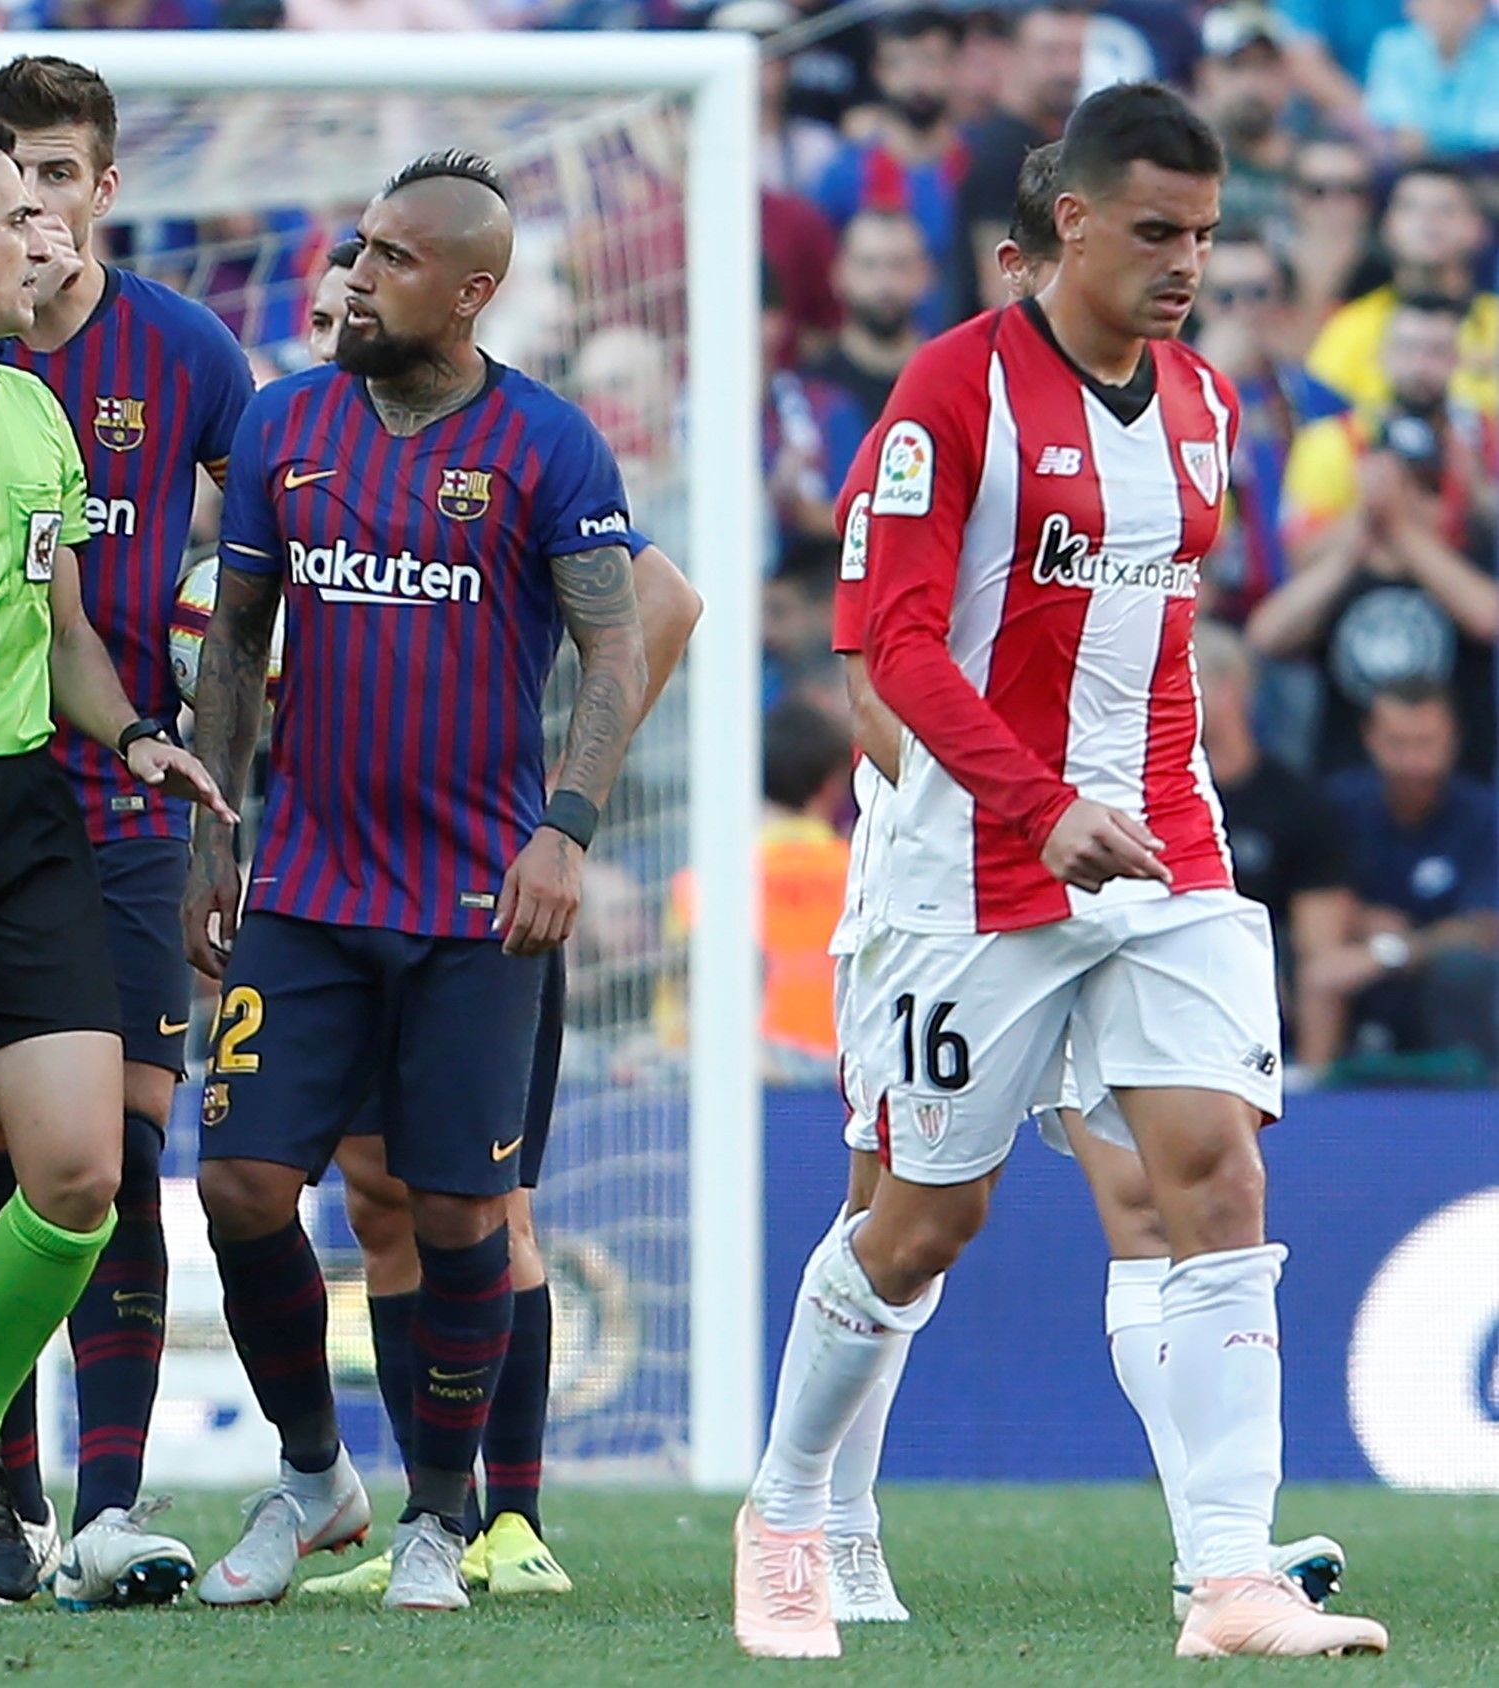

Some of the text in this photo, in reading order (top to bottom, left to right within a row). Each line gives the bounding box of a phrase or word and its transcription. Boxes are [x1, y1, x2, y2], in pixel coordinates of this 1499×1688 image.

[288, 539, 481, 603] Rakuten
[1034, 515, 1198, 597] Kutxaban
[893, 994, 970, 1089] 16
